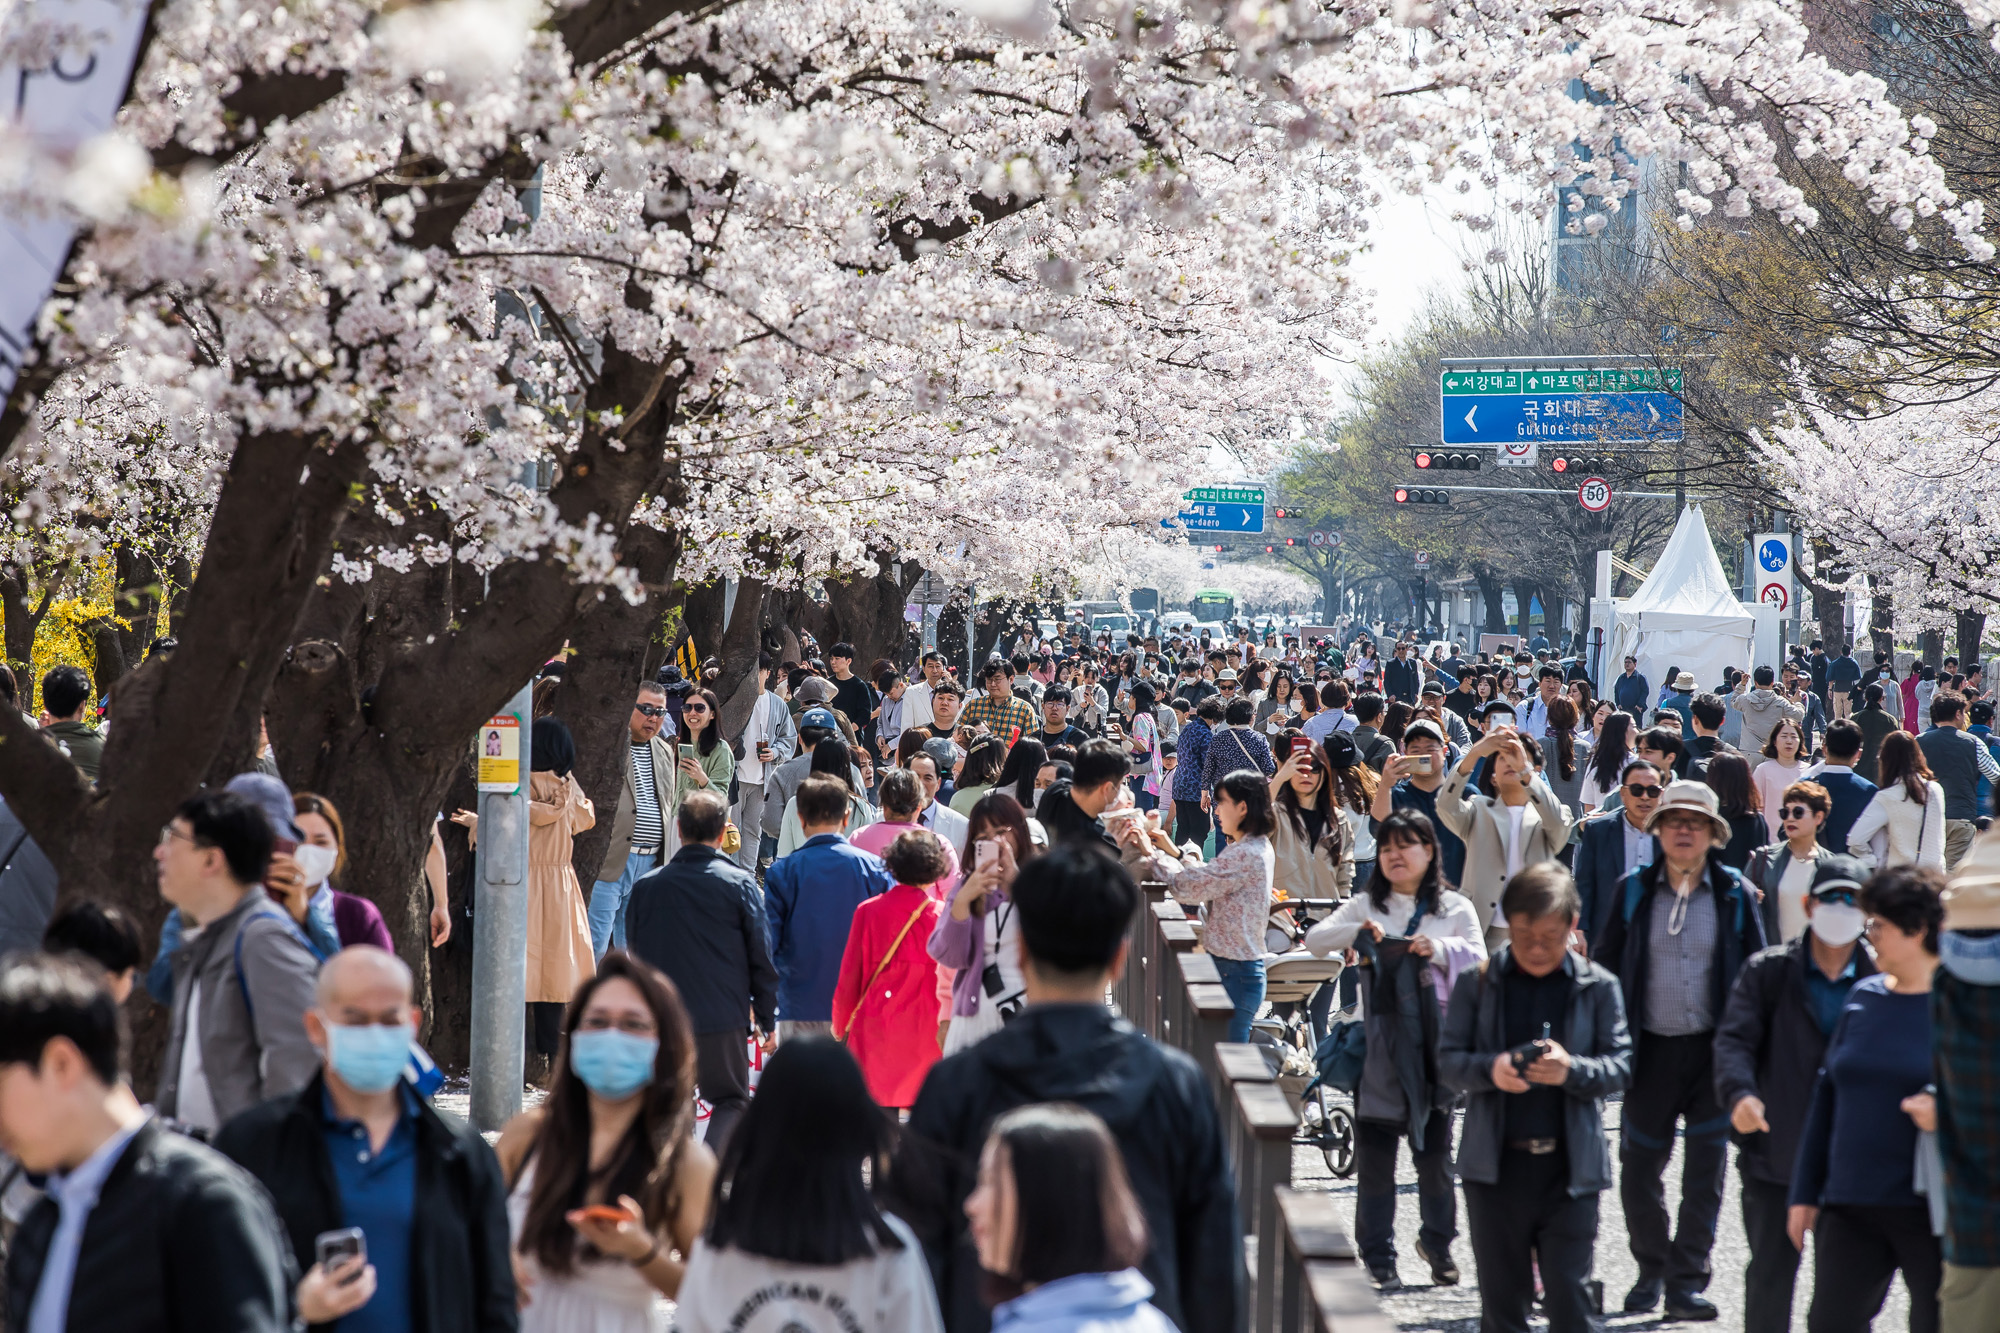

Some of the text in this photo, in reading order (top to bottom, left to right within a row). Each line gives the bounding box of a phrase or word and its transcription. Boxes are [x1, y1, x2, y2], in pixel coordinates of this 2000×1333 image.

[1462, 375, 1517, 390] 서강대교
[1542, 375, 1600, 389] 마포대교
[1523, 400, 1602, 420] 국회대로
[1586, 486, 1604, 501] 50
